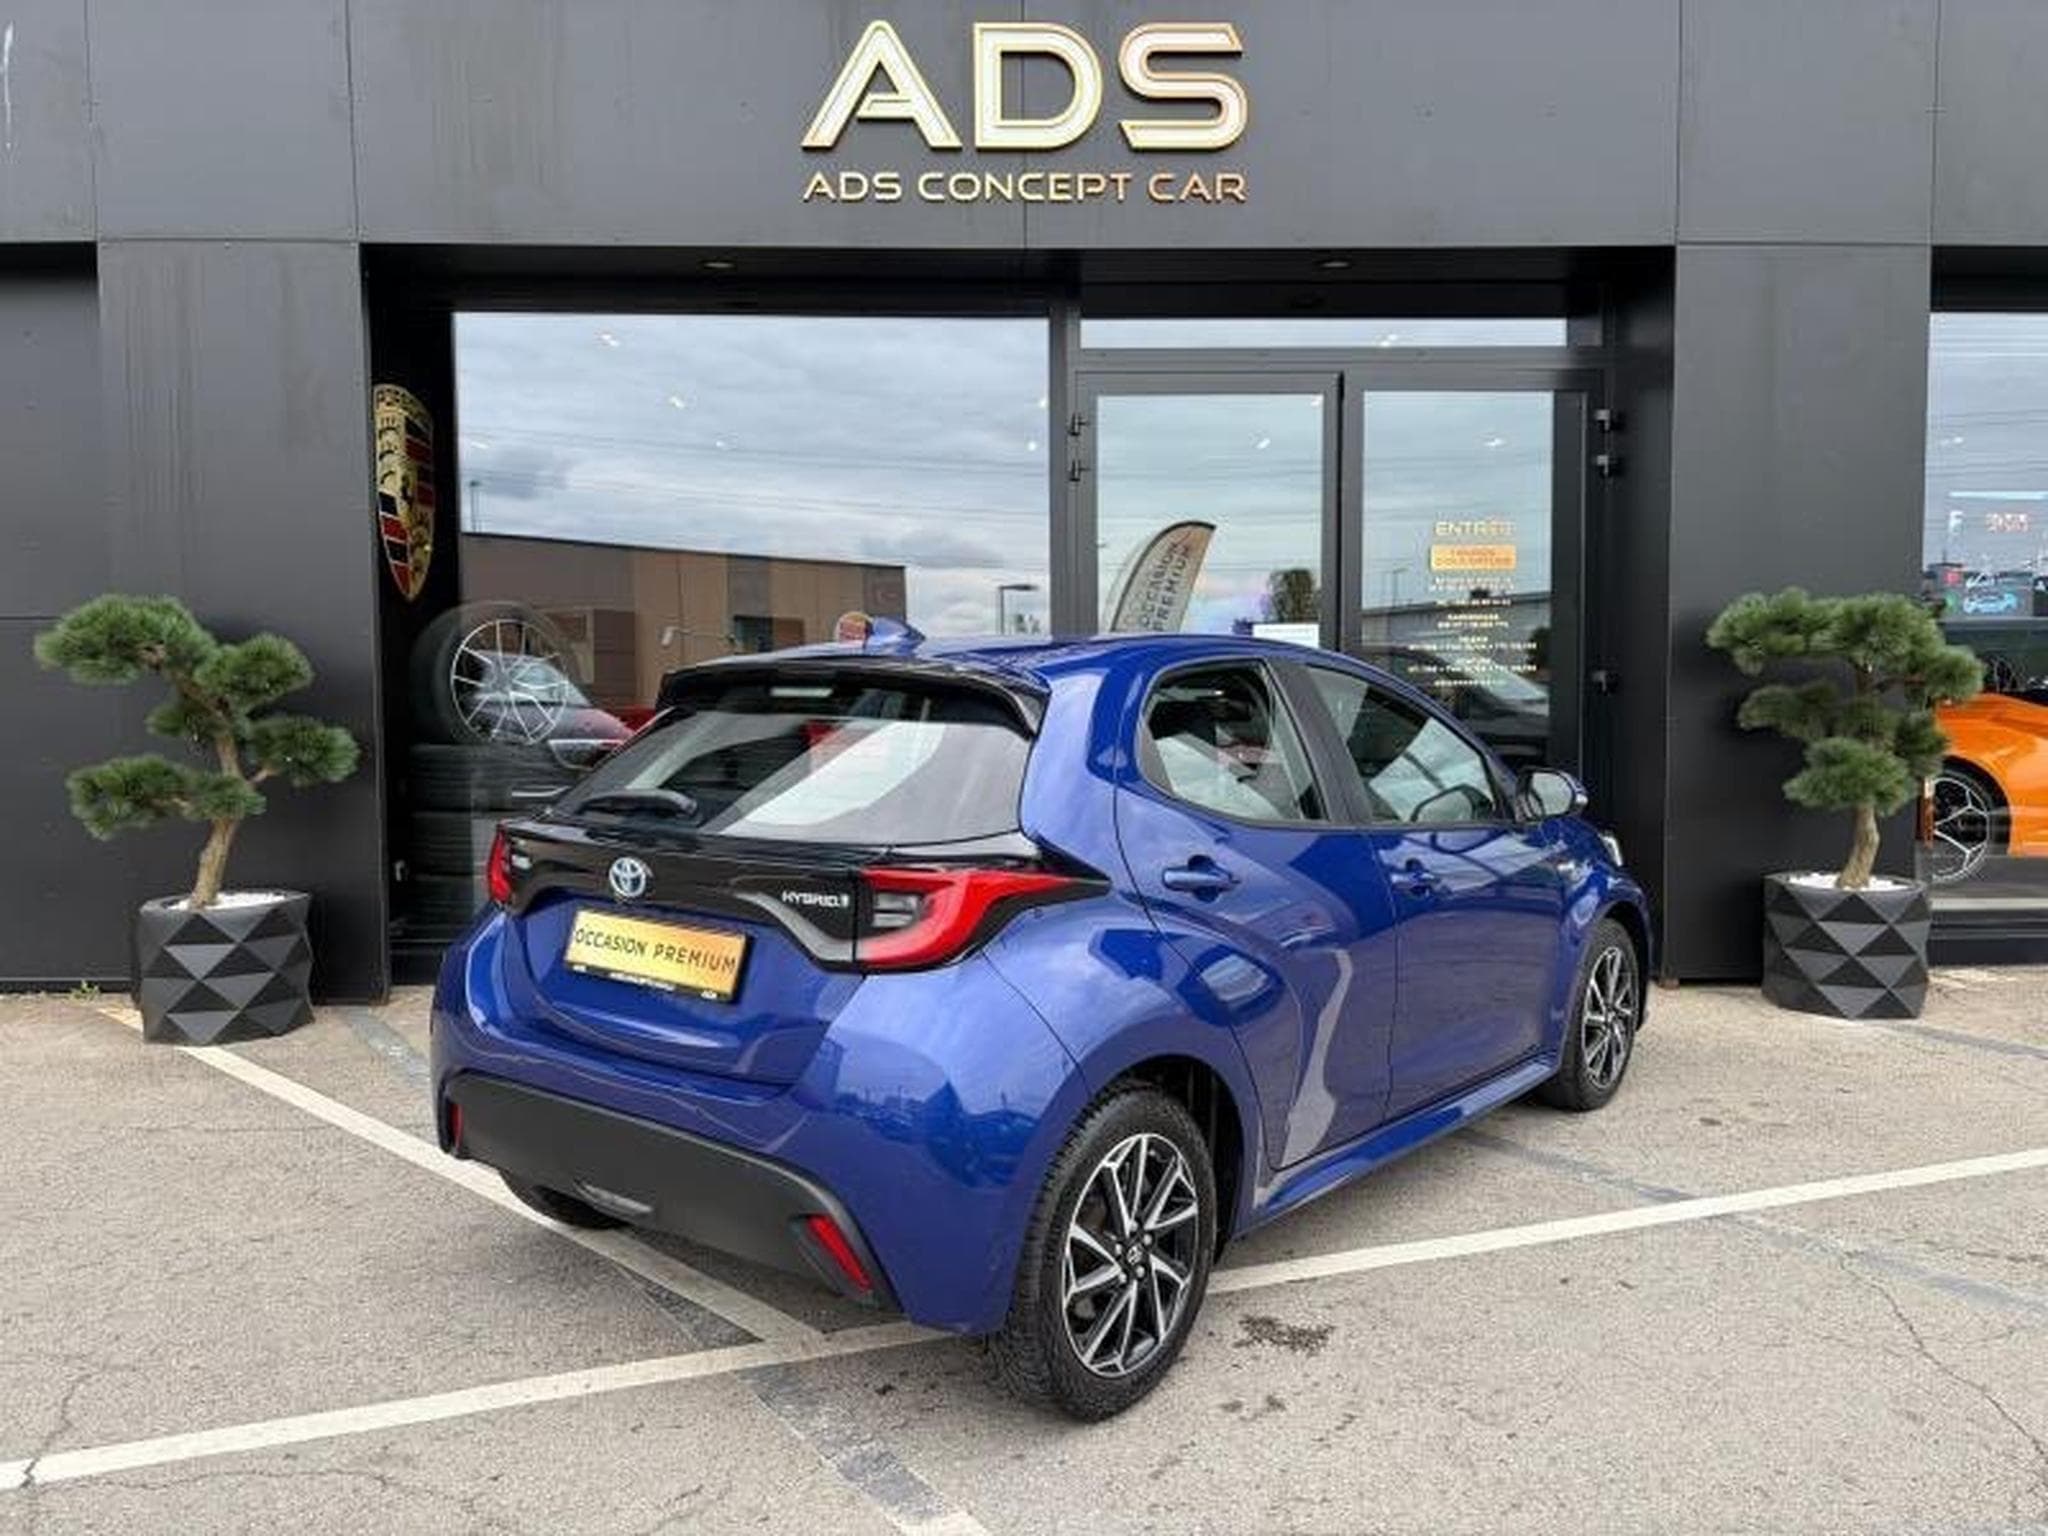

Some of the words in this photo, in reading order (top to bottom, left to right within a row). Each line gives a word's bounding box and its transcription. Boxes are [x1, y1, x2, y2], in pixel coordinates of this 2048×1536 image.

[800, 20, 1248, 151] ADS
[803, 172, 902, 201] ADS
[919, 172, 1132, 201] CONCEPT
[1149, 172, 1247, 201] CAR
[782, 890, 841, 908] HYBRID
[573, 926, 646, 957] OCCASION
[653, 943, 736, 974] PREMIUM
